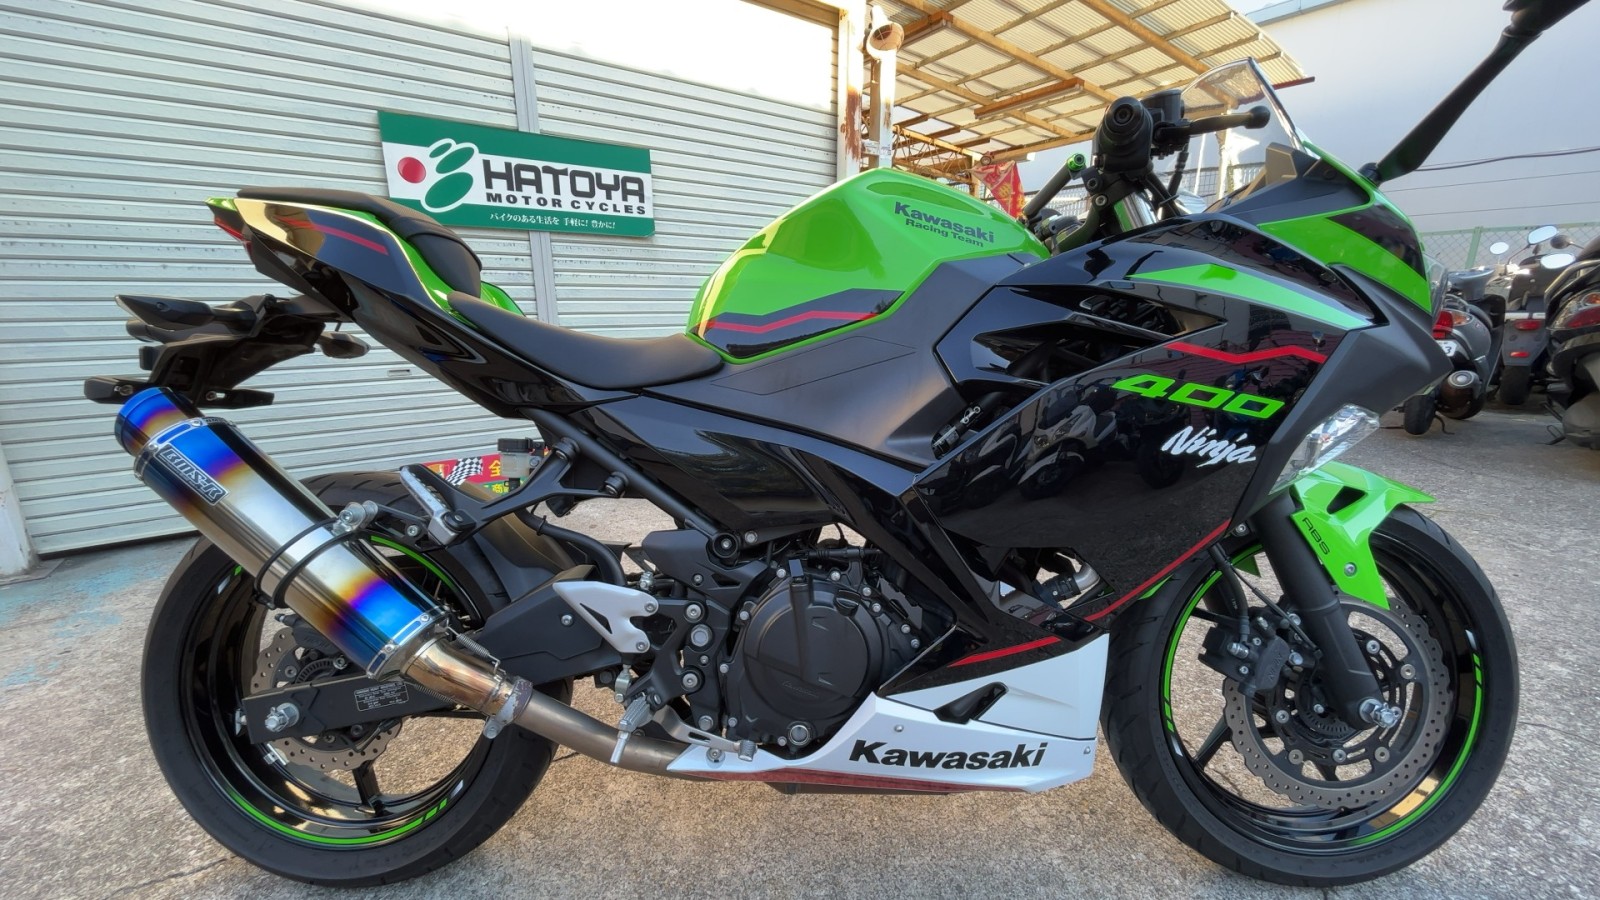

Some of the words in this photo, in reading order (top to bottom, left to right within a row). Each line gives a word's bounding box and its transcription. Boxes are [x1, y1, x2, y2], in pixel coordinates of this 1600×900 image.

[482, 158, 646, 204] HATOYA
[485, 192, 562, 208] MOTOR
[570, 200, 646, 215] CYCLES
[894, 201, 995, 243] Kawasaki
[905, 218, 949, 238] Racing
[950, 231, 984, 248] Team
[1111, 374, 1286, 420] 400
[1160, 425, 1257, 469] Ninja
[1301, 516, 1332, 556] ABS
[848, 739, 1049, 771] Kawasaki
